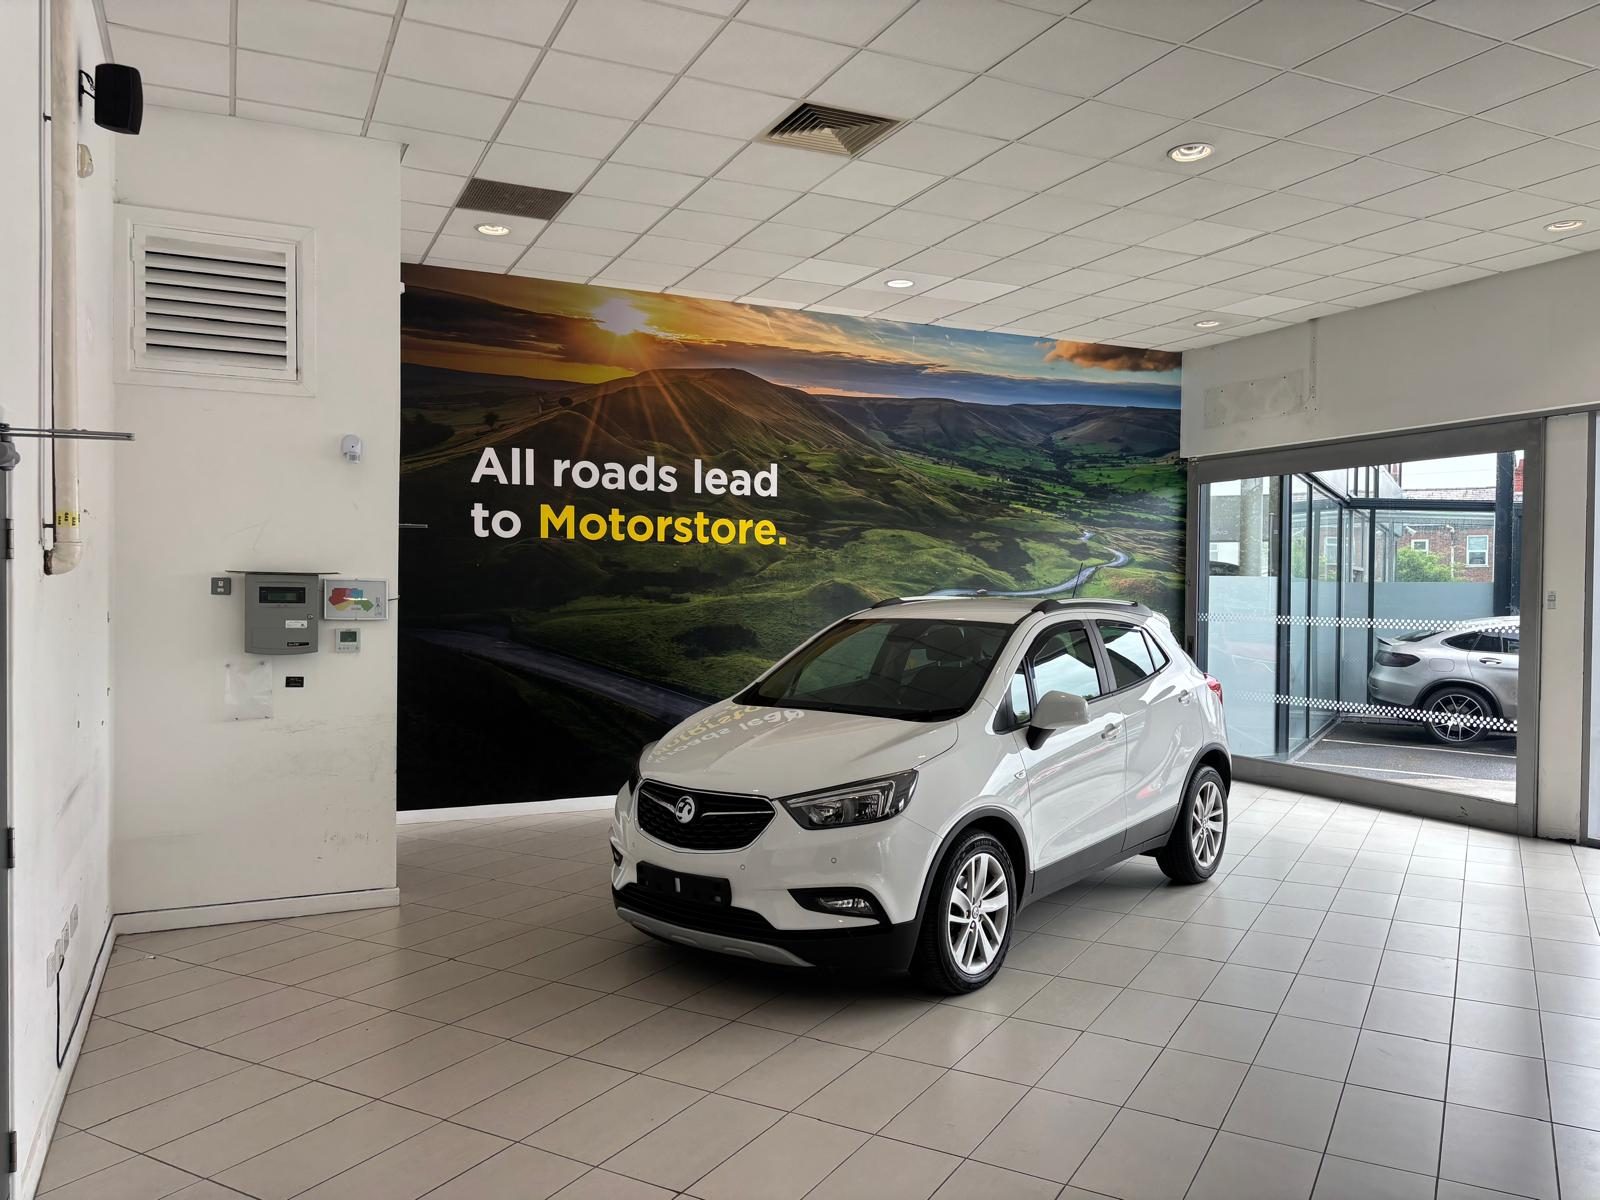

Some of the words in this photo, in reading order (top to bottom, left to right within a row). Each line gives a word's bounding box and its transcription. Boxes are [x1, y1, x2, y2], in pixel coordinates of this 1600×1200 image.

[471, 447, 535, 486] All
[553, 456, 678, 493] roads
[694, 459, 778, 497] lead
[471, 502, 521, 539] to
[540, 503, 787, 545] Motorstore.
